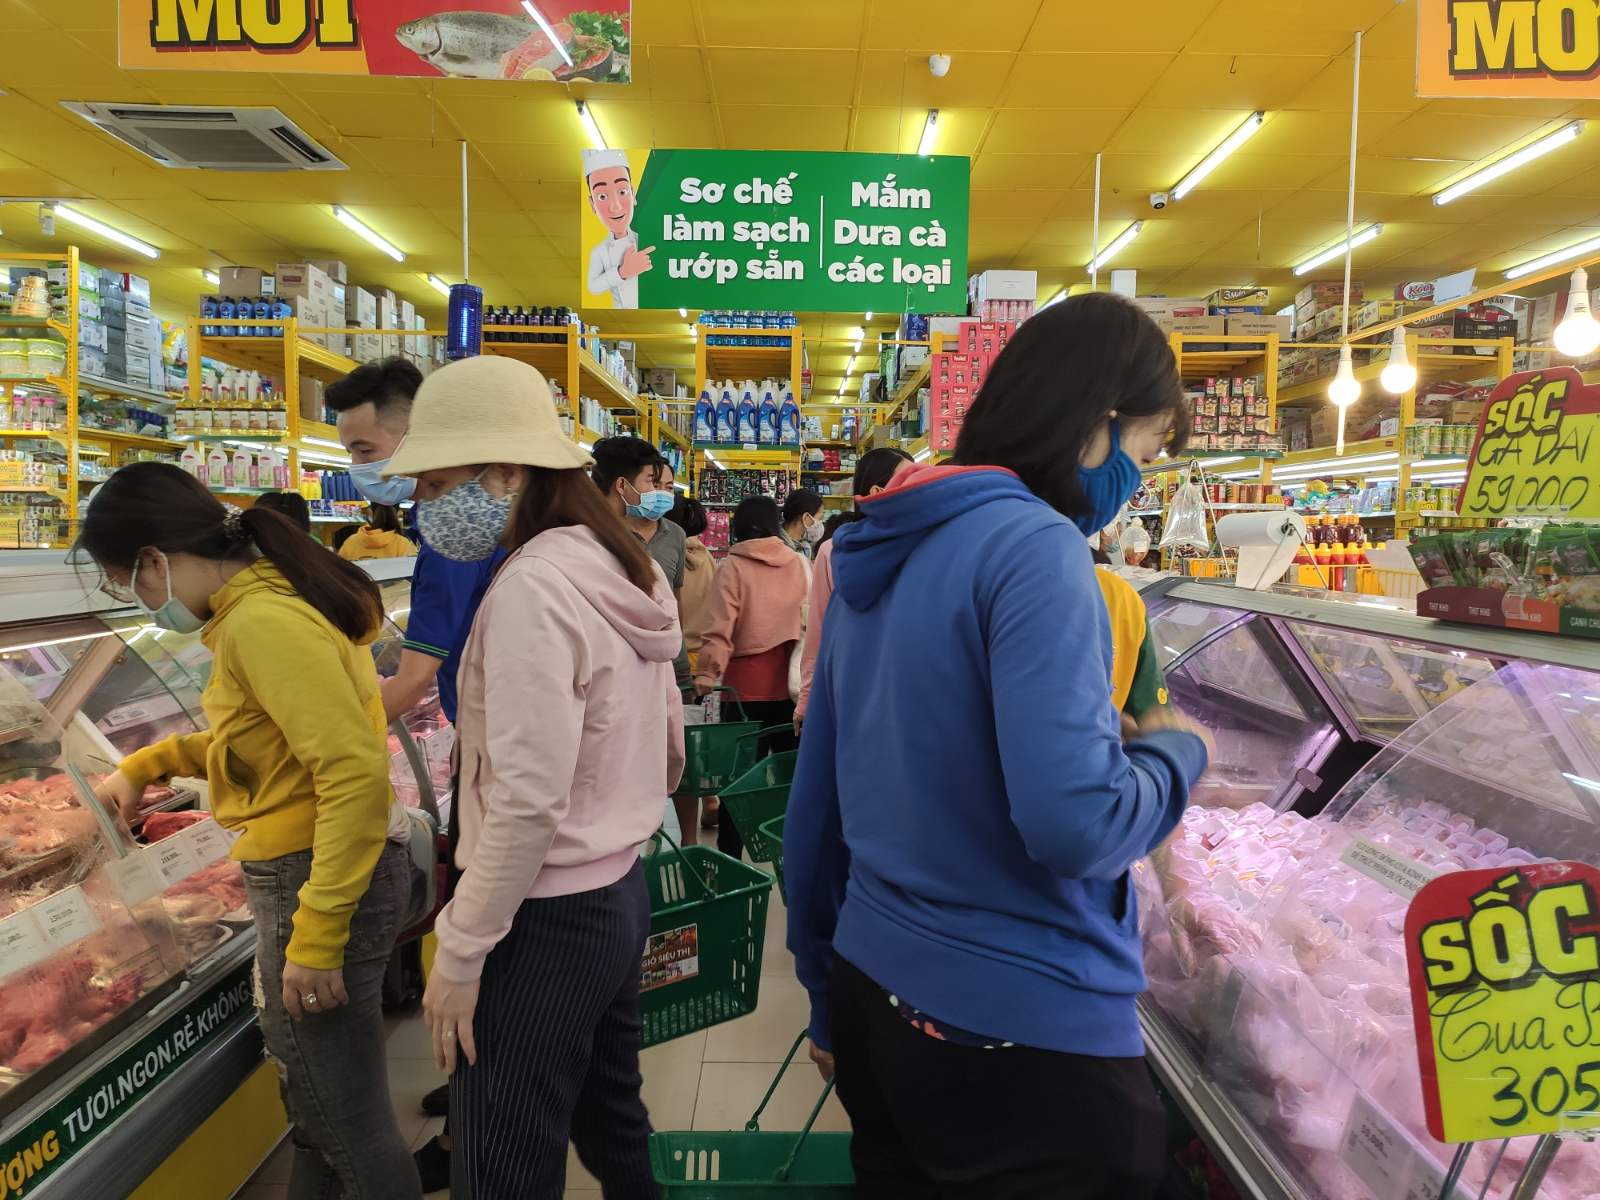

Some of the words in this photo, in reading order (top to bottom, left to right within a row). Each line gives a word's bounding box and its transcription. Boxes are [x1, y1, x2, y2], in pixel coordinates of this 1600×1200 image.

[680, 177, 726, 204] Sơ
[733, 171, 799, 205] chế
[851, 173, 931, 209] Mắm
[663, 214, 725, 242] làm
[733, 216, 809, 250] sạch
[834, 219, 902, 246] Dưa
[908, 219, 947, 247] cà
[668, 252, 738, 284] ướp
[746, 249, 804, 280] sẵn
[827, 255, 885, 284] các
[892, 258, 951, 292] loại
[1483, 374, 1568, 436] SỐC
[1421, 869, 1600, 990] SỐC
